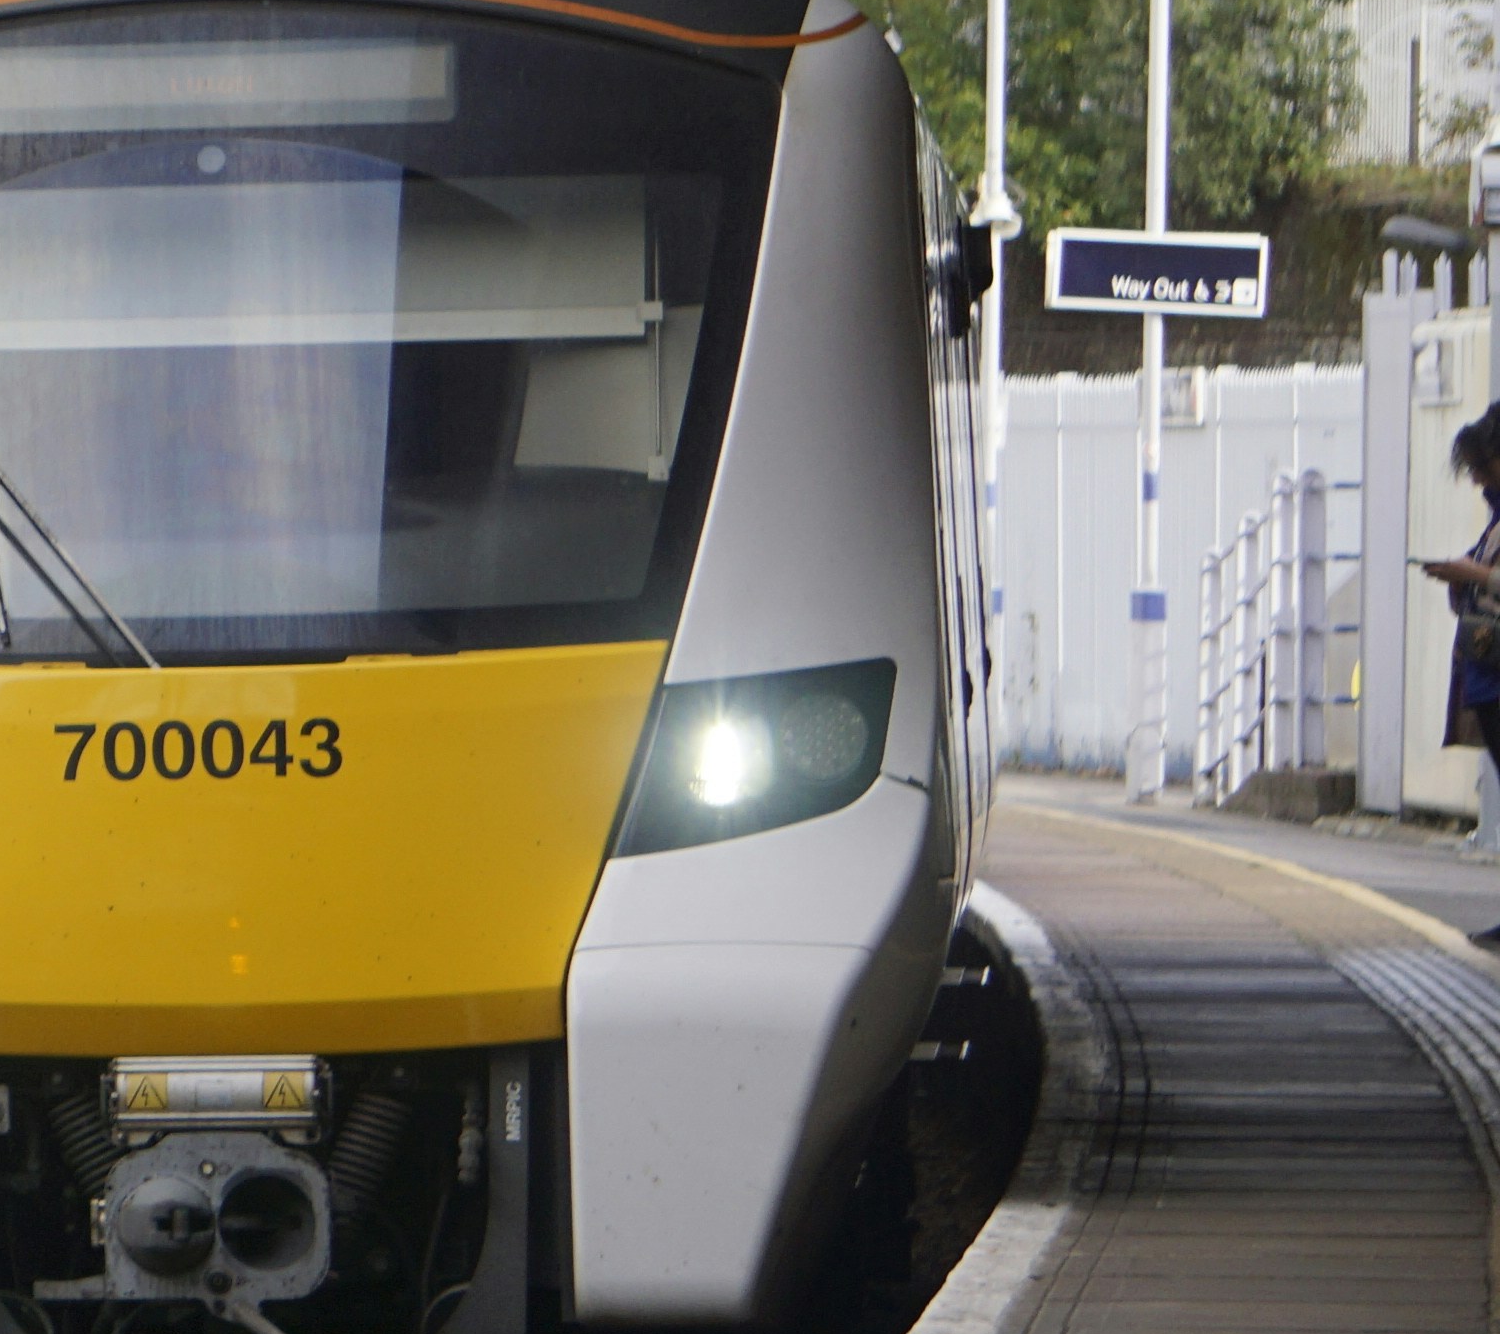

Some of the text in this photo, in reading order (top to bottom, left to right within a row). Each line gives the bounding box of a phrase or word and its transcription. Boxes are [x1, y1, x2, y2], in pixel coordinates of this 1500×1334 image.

[1111, 274, 1190, 302] Way Out
[53, 717, 343, 781] 700043
[505, 1080, 521, 1142] MRPIC
